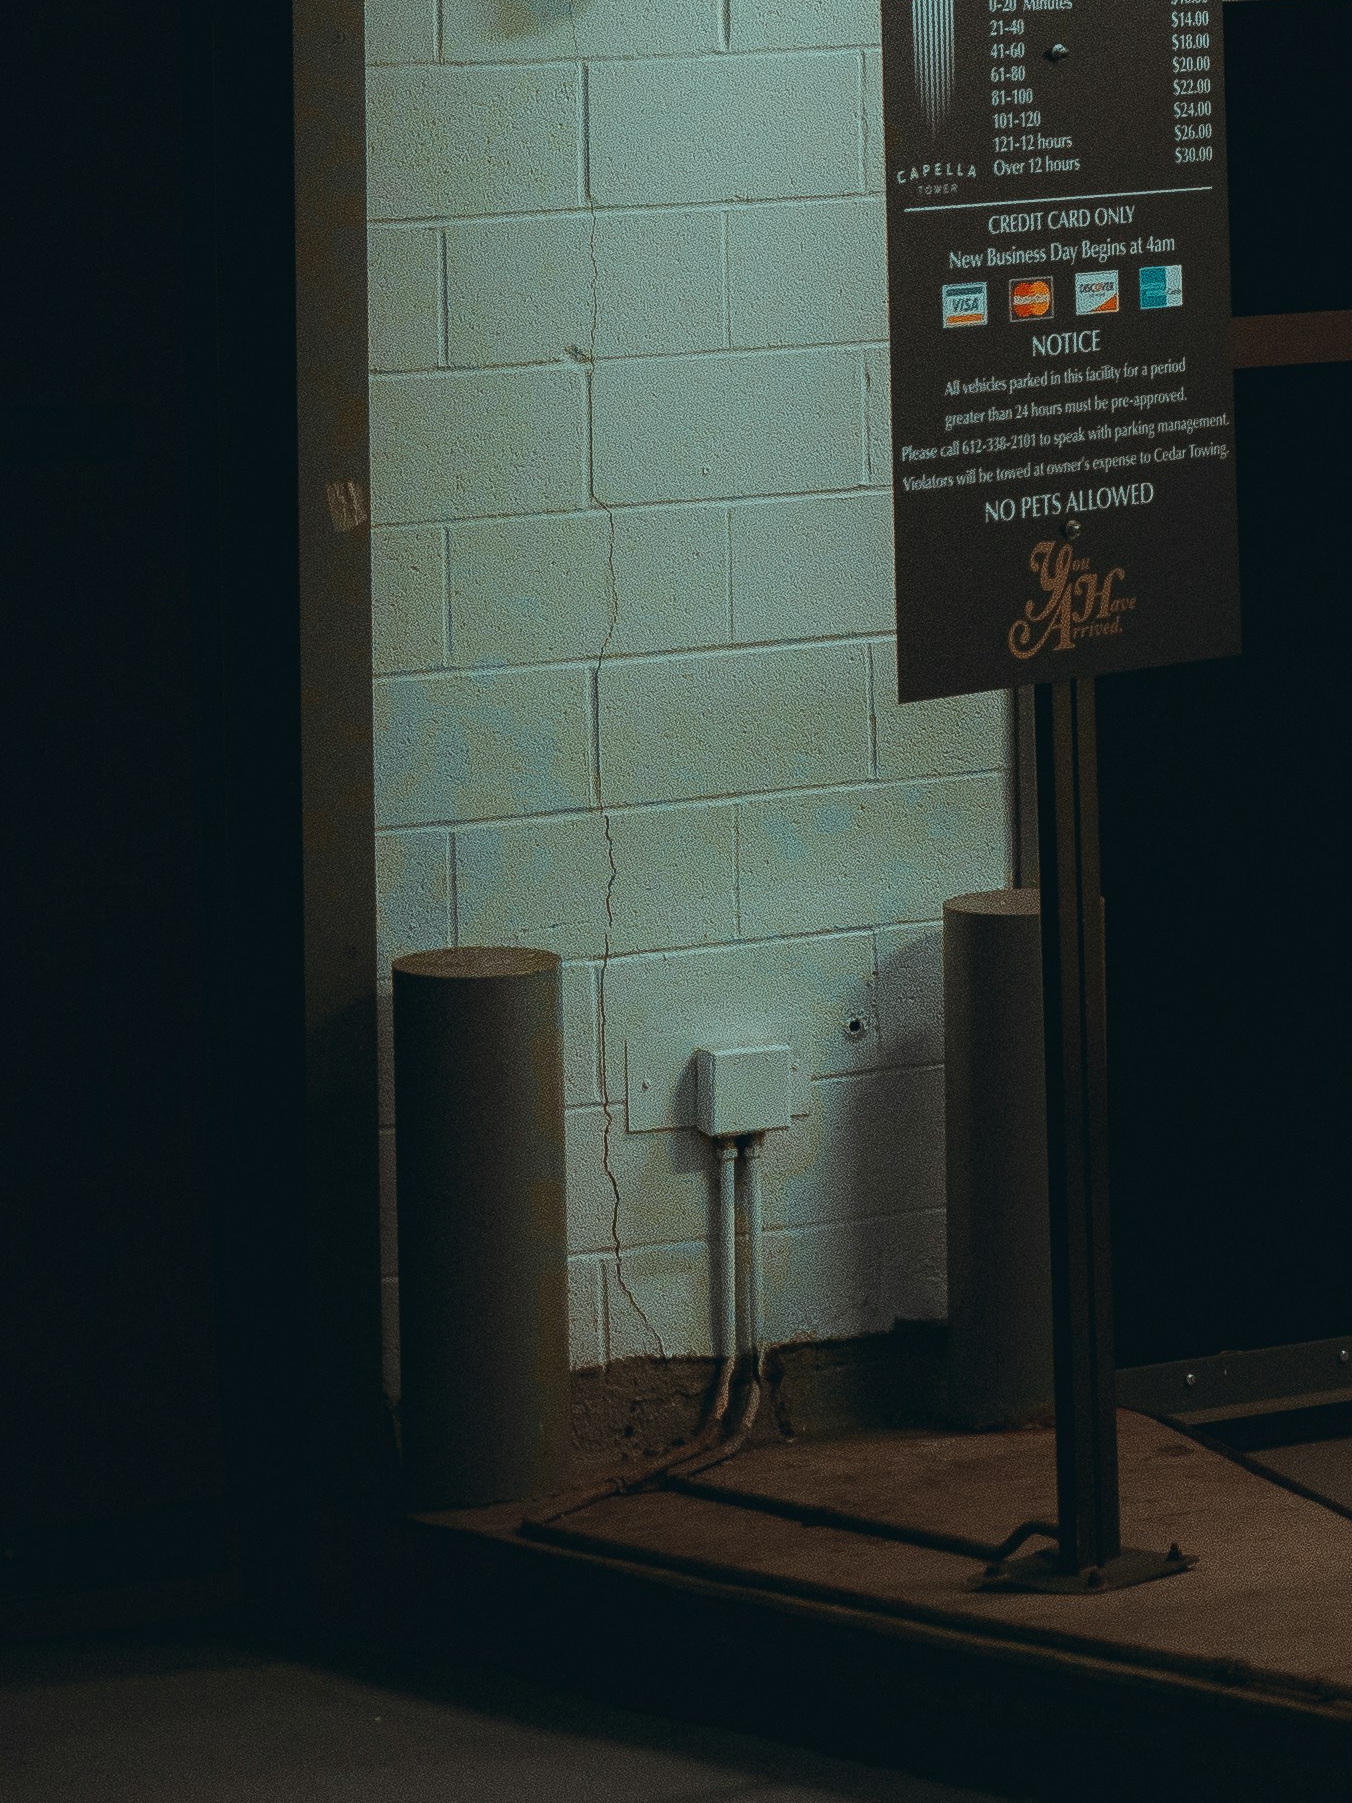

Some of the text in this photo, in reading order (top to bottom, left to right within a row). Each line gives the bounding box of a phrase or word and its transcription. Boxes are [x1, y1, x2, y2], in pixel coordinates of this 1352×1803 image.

[990, 11, 1209, 36] 21-40 $14.00
[990, 33, 1210, 59] 41-60 $18.00
[991, 56, 1210, 82] 61-80 $20.00
[991, 78, 1211, 106] 81-100 $22.00
[993, 101, 1211, 129] 101-120 $24.00
[993, 123, 1212, 152] 121-12 hours $26.00
[896, 163, 976, 184] CAPELLA
[993, 146, 1213, 176] Over 12 hours $30.00
[988, 205, 1135, 235] CREDIT CARD ONLY
[949, 235, 1175, 269] New Business Day Begins at 4am
[953, 297, 980, 312] VISA
[1032, 329, 1100, 357] NOTICE
[944, 356, 1186, 396] All vehicles parked in this facility for a period
[944, 386, 1188, 432] greater than 24 hours must be pre-approved.
[901, 445, 937, 462] Please
[940, 440, 960, 457] call
[1039, 433, 1050, 445] to
[1054, 426, 1085, 449] speak
[1088, 424, 1112, 440] with
[1114, 421, 1155, 443] parking
[1157, 413, 1230, 434] management.
[902, 473, 954, 492] Violators
[957, 468, 976, 485] will
[979, 466, 994, 482] be
[996, 462, 1031, 482] towed
[1034, 463, 1044, 476] at
[1046, 456, 1091, 475] owner's
[1093, 454, 1137, 473] expense
[1140, 451, 1151, 464] to
[1154, 445, 1186, 463] Cedar
[985, 482, 1155, 523] NO PETS ALLOWED
[1024, 540, 1090, 622] You
[1072, 567, 1137, 623] Have
